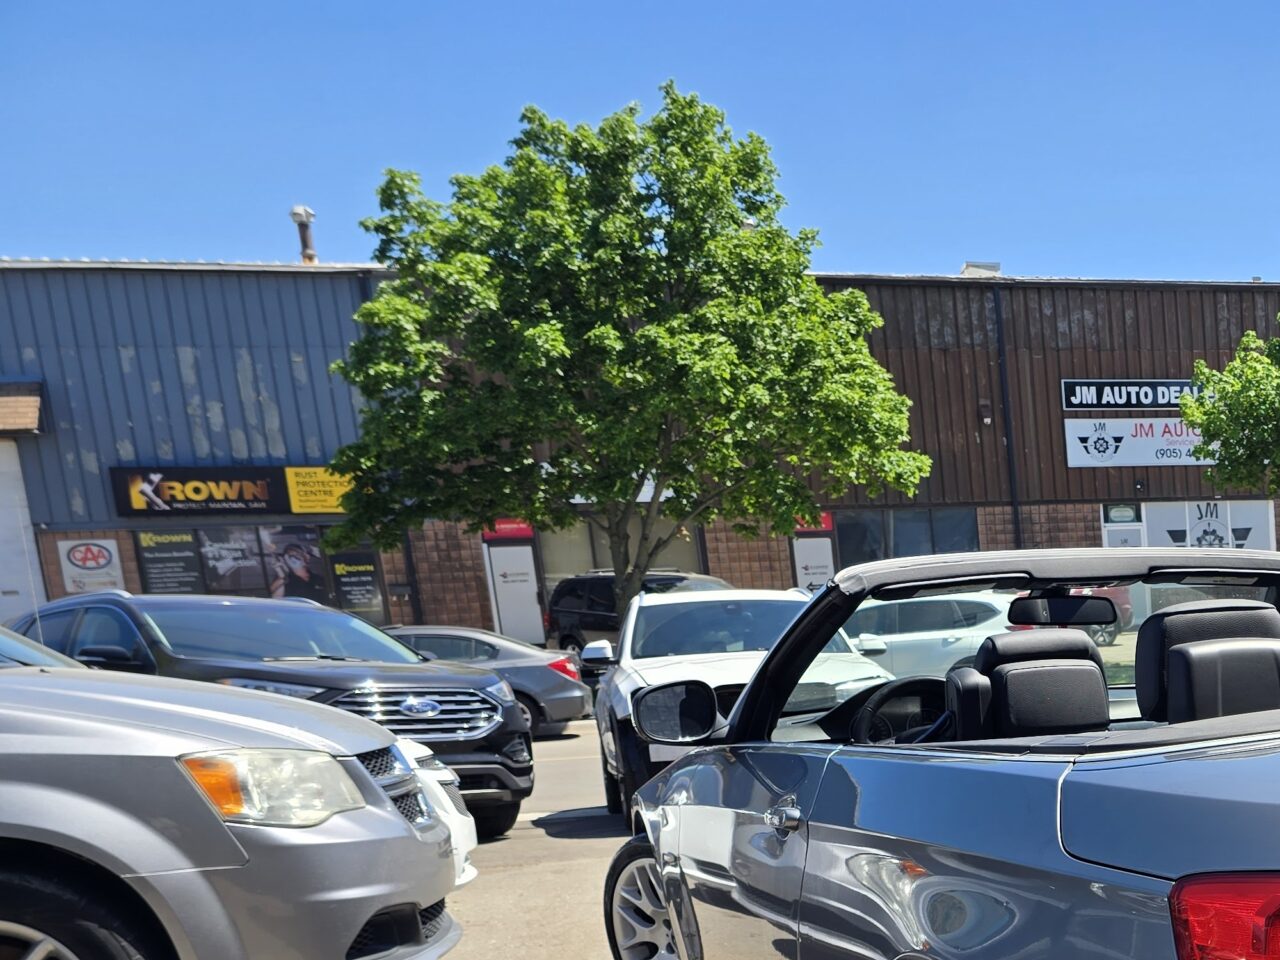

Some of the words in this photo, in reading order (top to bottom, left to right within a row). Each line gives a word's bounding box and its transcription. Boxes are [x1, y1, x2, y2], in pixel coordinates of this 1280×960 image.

[1070, 386, 1097, 404] JM
[1101, 386, 1153, 404] AUTO
[1157, 386, 1206, 404] DEAL
[1131, 423, 1154, 438] JM
[1155, 448, 1182, 460] (905)
[129, 472, 270, 510] KROWN
[296, 481, 349, 489] PROTECTIO
[72, 544, 108, 566] CAA
